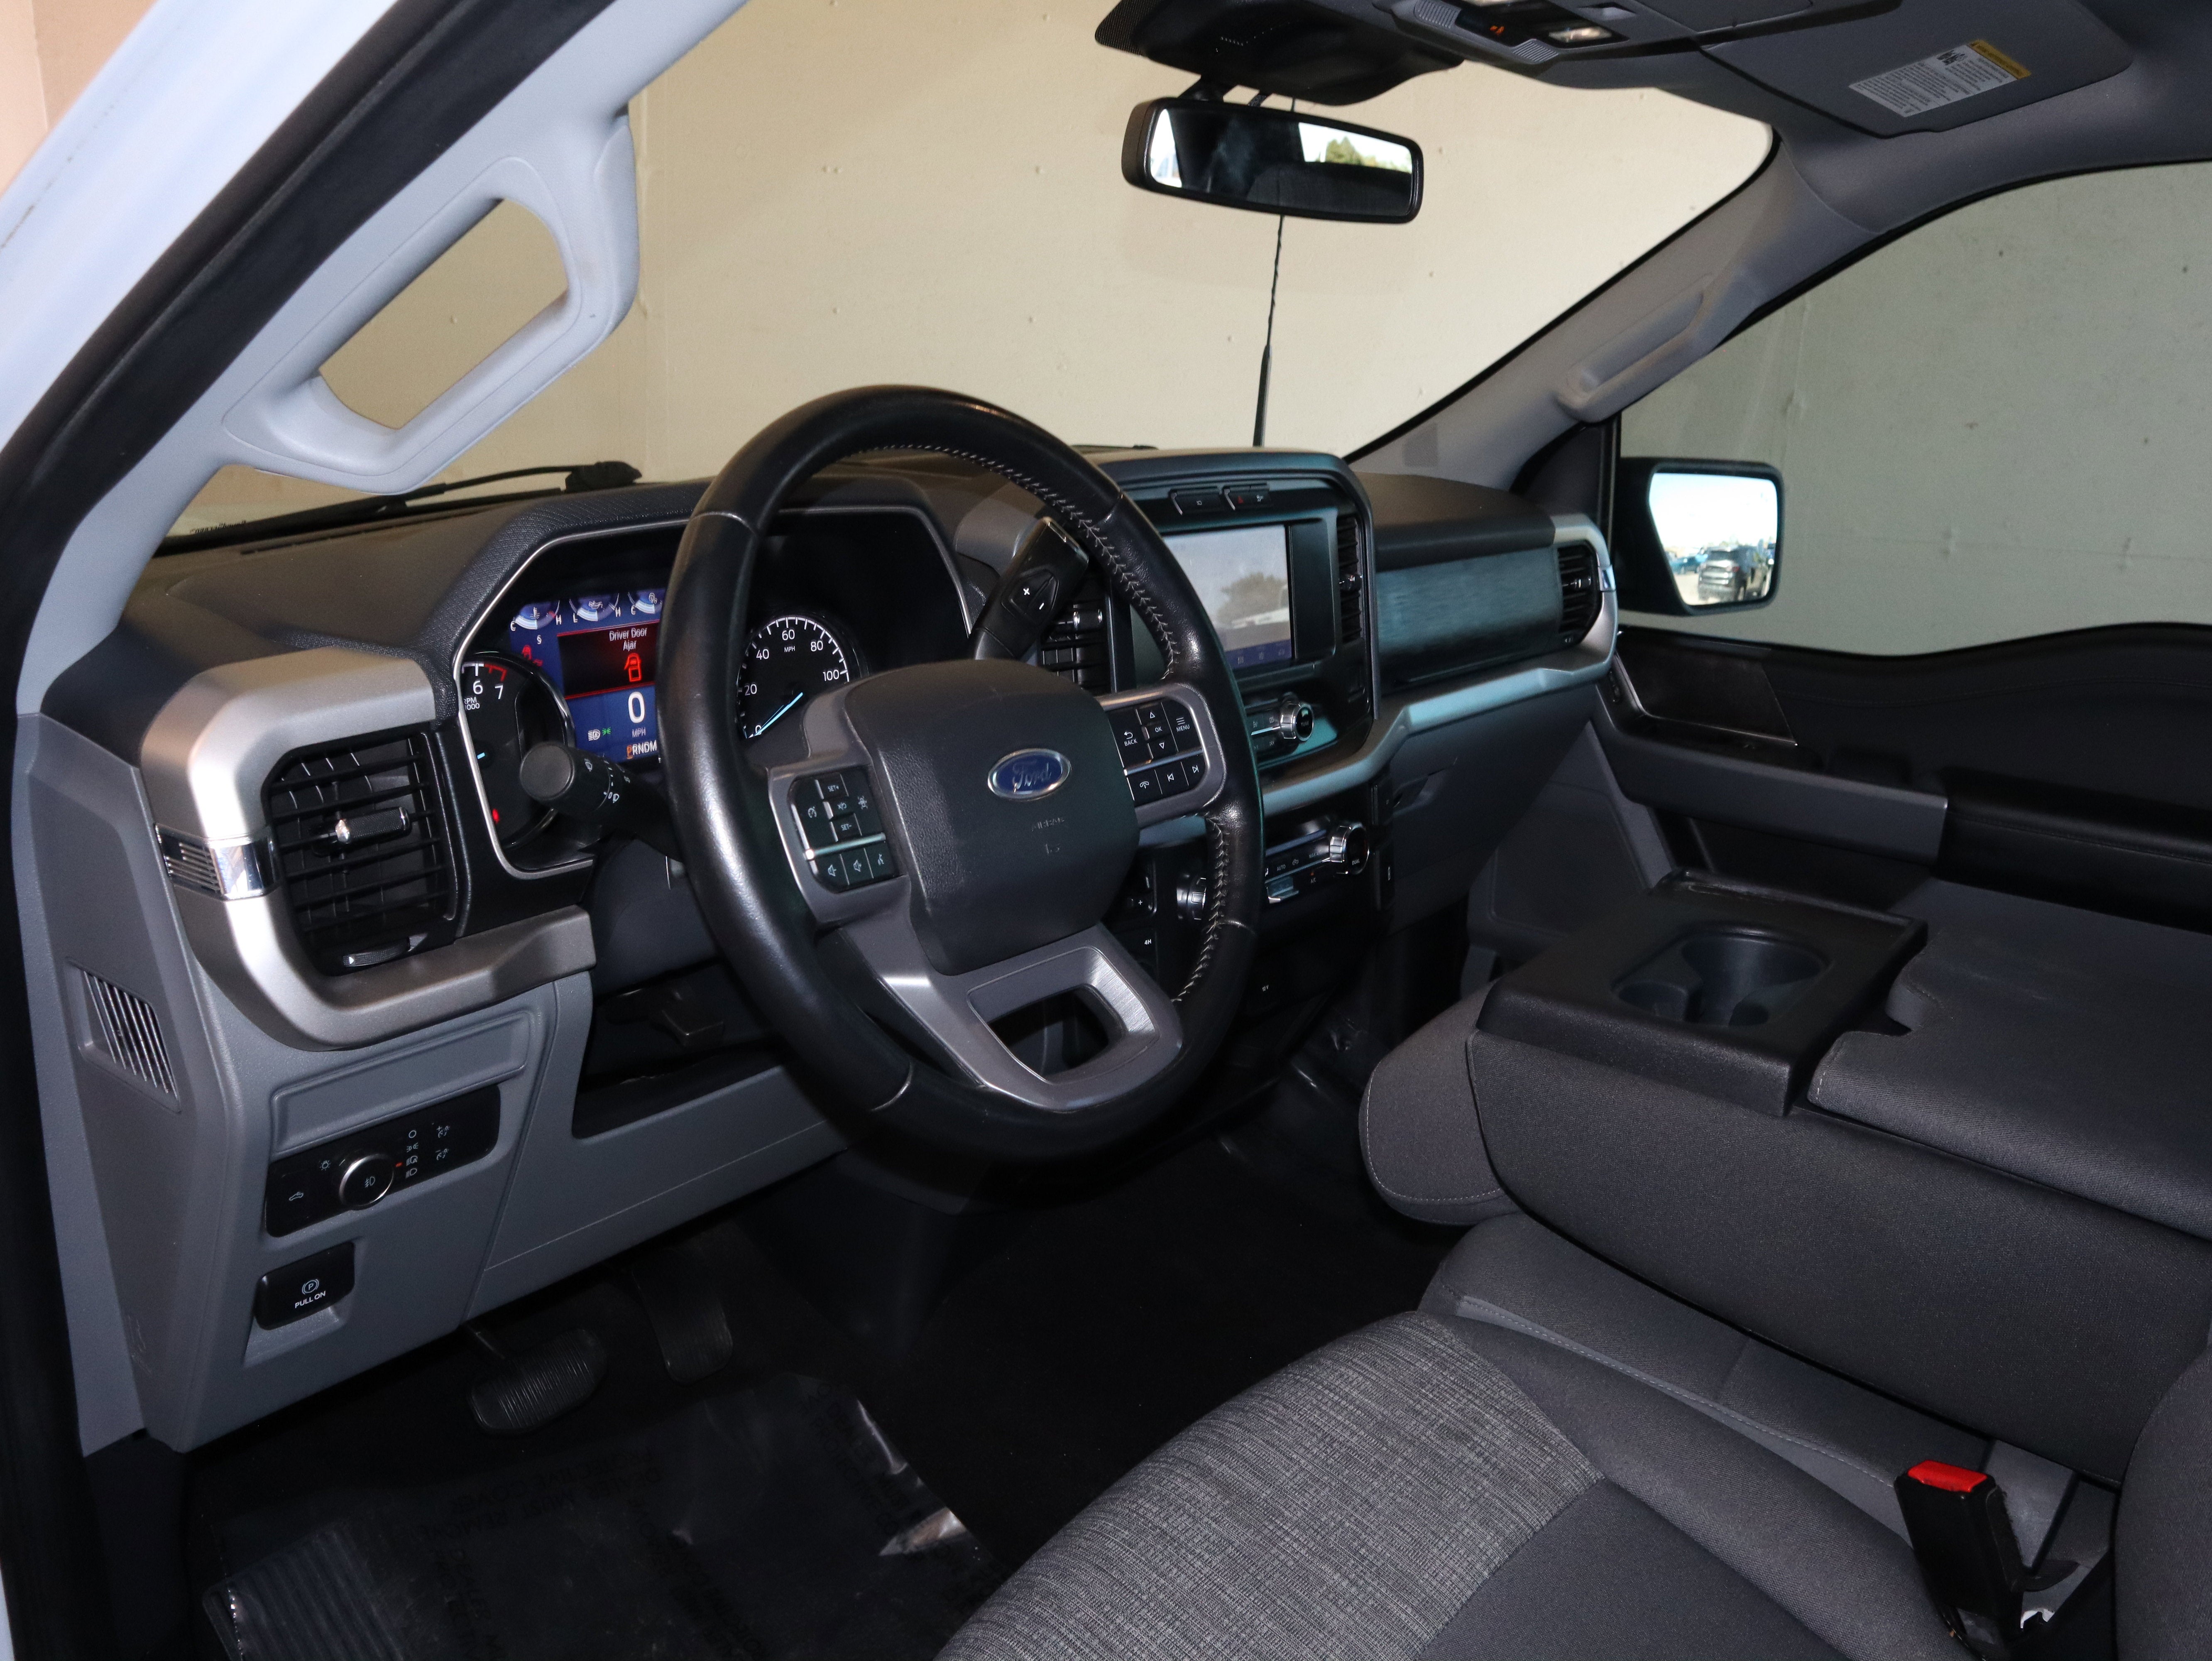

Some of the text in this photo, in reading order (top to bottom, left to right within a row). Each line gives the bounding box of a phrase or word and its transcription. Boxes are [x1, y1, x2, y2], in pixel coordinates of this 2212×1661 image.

[573, 612, 578, 623] L
[615, 607, 622, 617] H
[510, 621, 516, 631] C
[555, 615, 562, 625] H
[609, 627, 648, 642] Driver Door
[782, 629, 795, 641] 60
[623, 640, 637, 652] Ajar
[810, 640, 824, 652] 80
[756, 649, 769, 660] 40
[822, 669, 840, 682] 100
[473, 679, 483, 695] 6
[494, 684, 504, 700] 7
[744, 684, 757, 696] 20
[464, 696, 477, 705] RPM
[628, 691, 646, 723] 0
[631, 727, 646, 738] MPH
[1124, 738, 1138, 747] BACK
[1012, 759, 1052, 790] Ford
[295, 1290, 326, 1309] PULL ON
